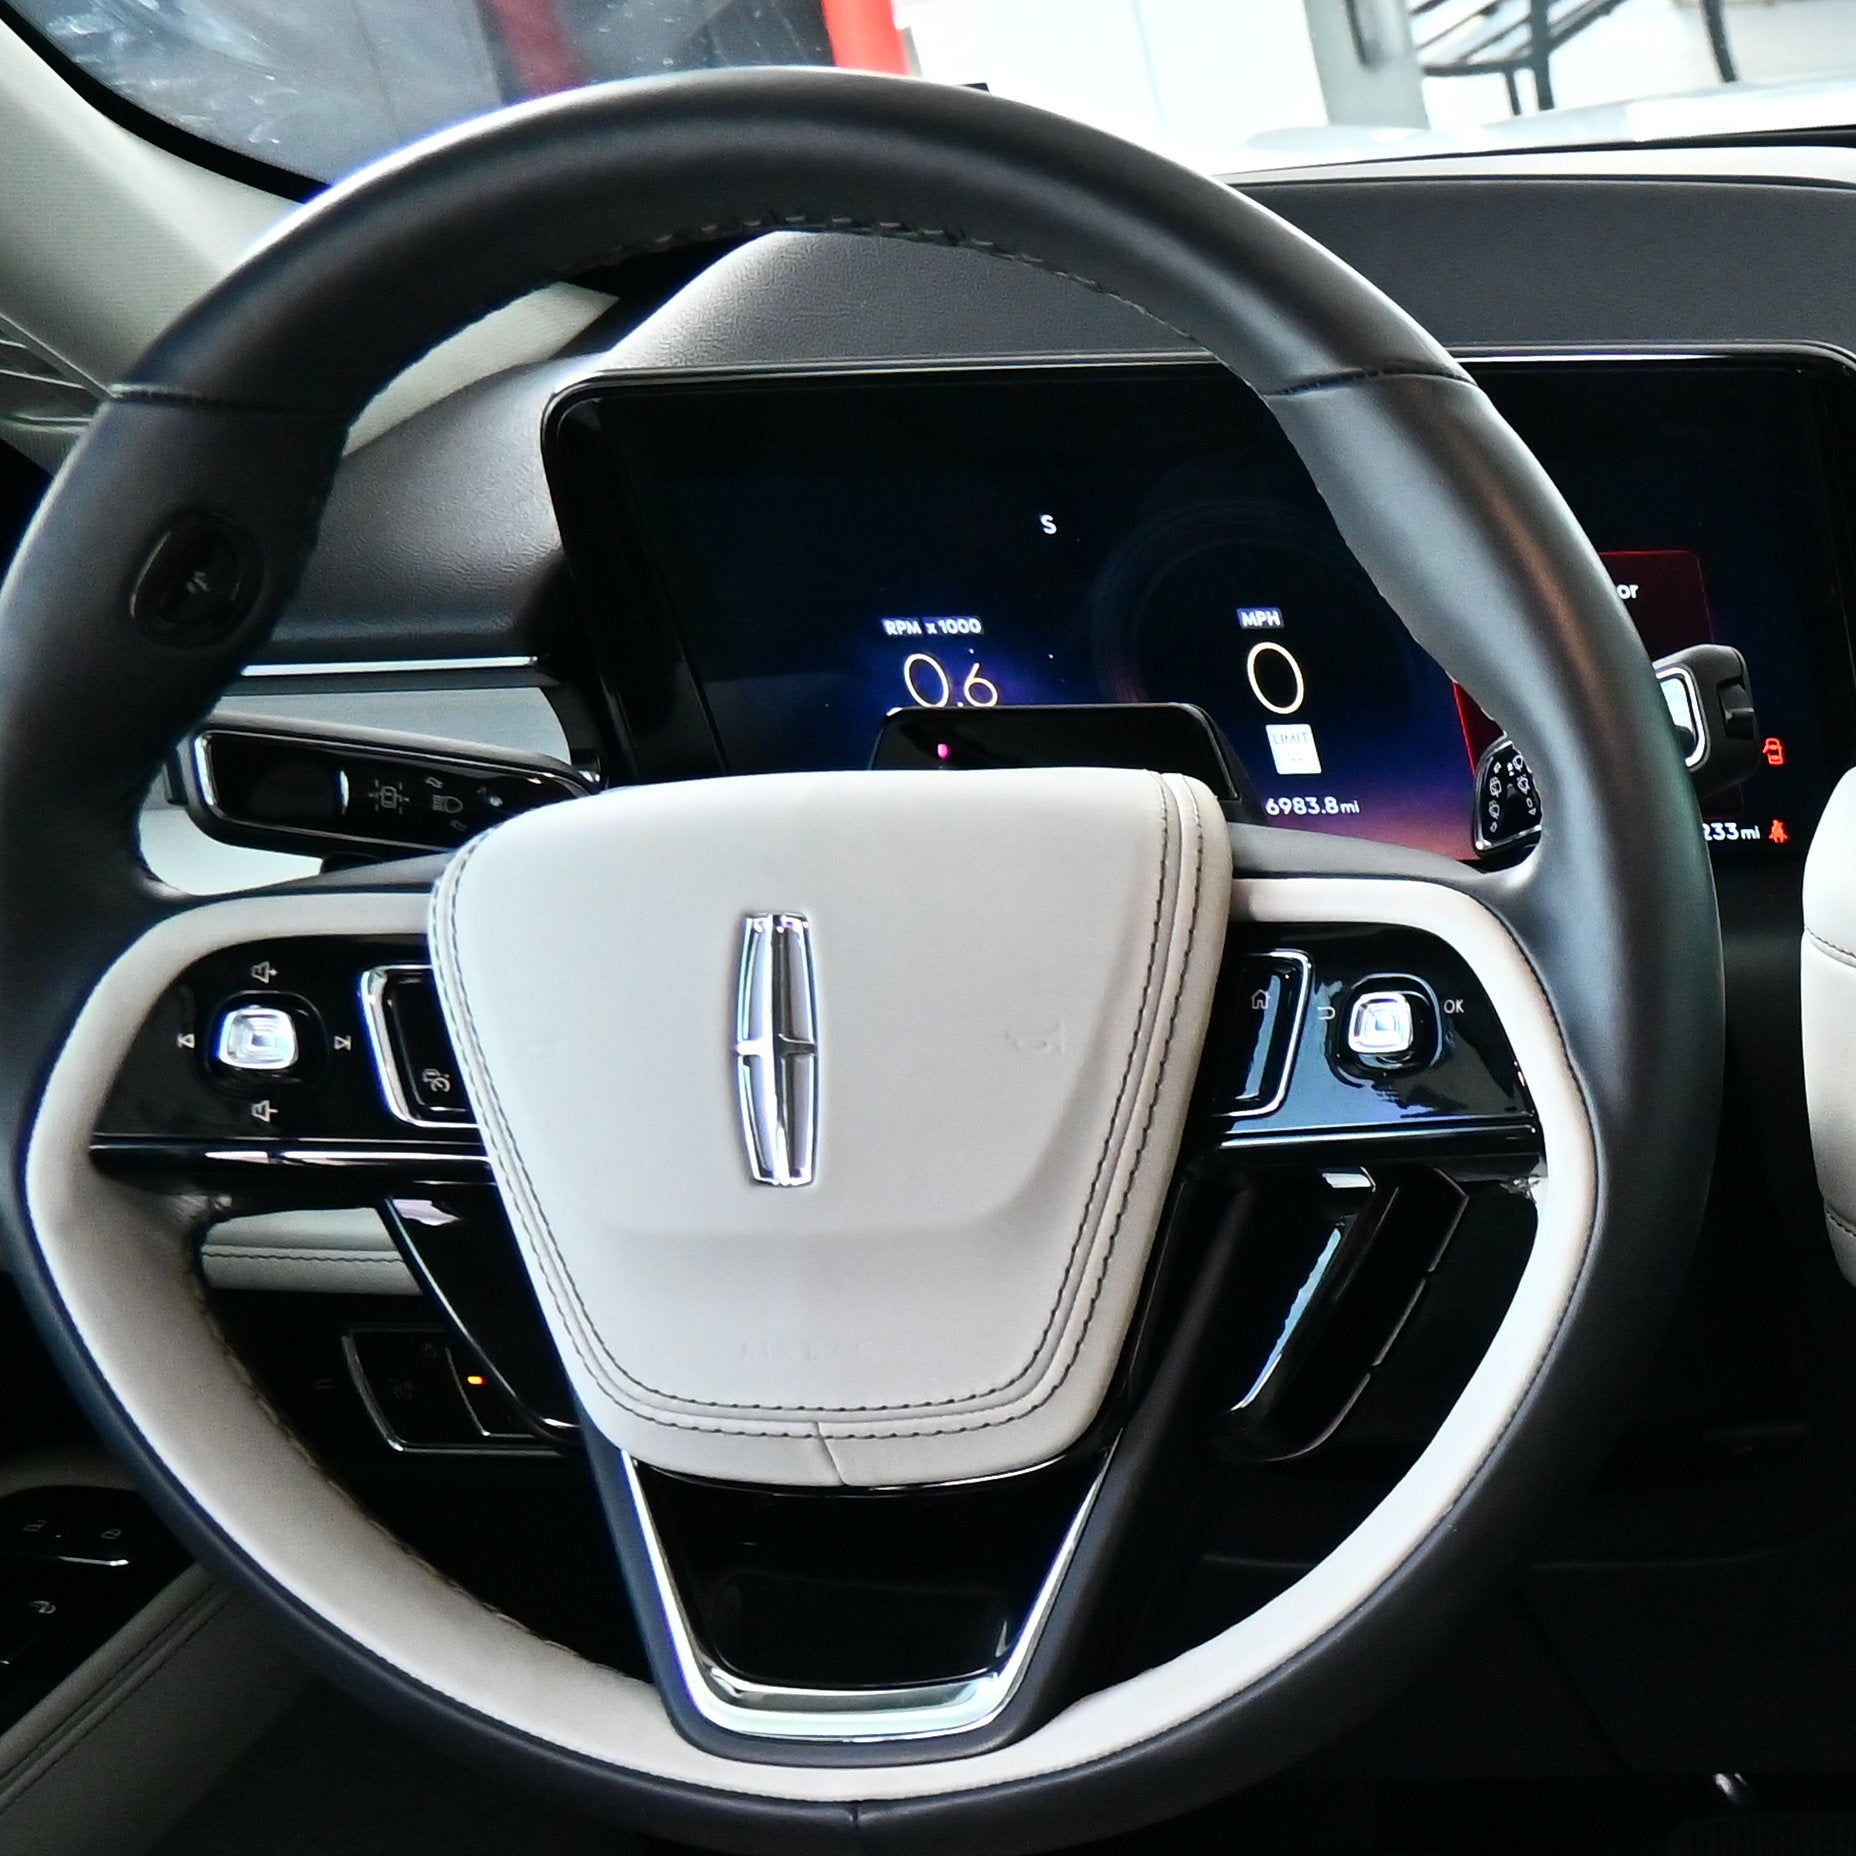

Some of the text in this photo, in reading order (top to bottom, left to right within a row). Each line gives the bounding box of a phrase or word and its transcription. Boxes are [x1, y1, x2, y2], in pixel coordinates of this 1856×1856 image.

[1040, 514, 1057, 534] S
[883, 619, 922, 635] RPM
[1240, 611, 1281, 627] MPH
[903, 653, 998, 708] 0.6
[1247, 642, 1304, 714] 0
[1444, 999, 1465, 1014] OK
